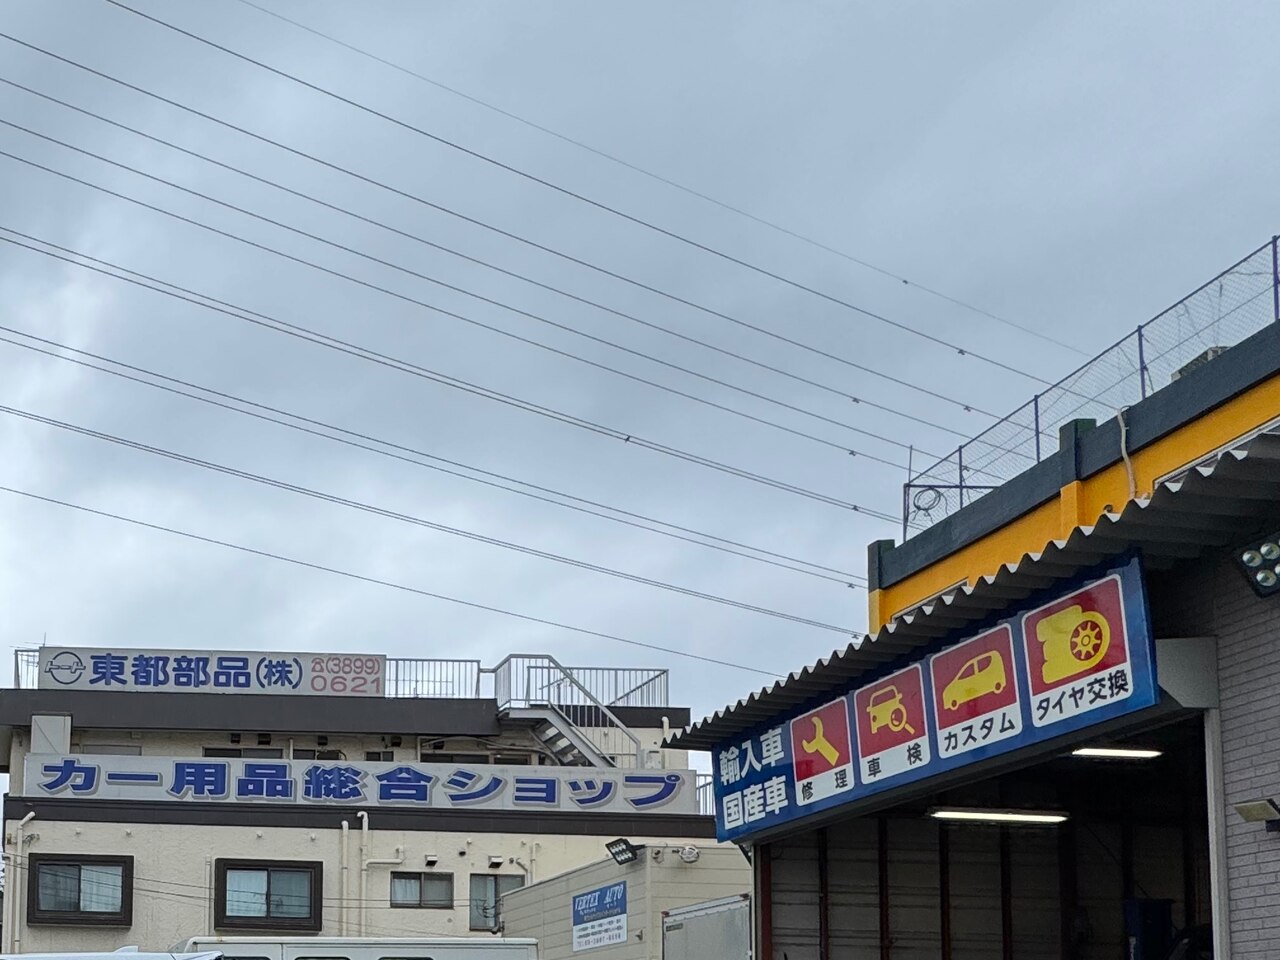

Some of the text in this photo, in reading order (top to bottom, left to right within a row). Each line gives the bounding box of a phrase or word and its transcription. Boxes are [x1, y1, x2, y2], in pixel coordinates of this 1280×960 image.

[311, 675, 381, 693] 0621
[1036, 669, 1129, 722] タイヤ交換
[719, 727, 786, 786] 輸入車
[943, 712, 1016, 752] カスタム
[41, 759, 682, 807] カー用品総合ショップ
[722, 774, 789, 831] 国産車
